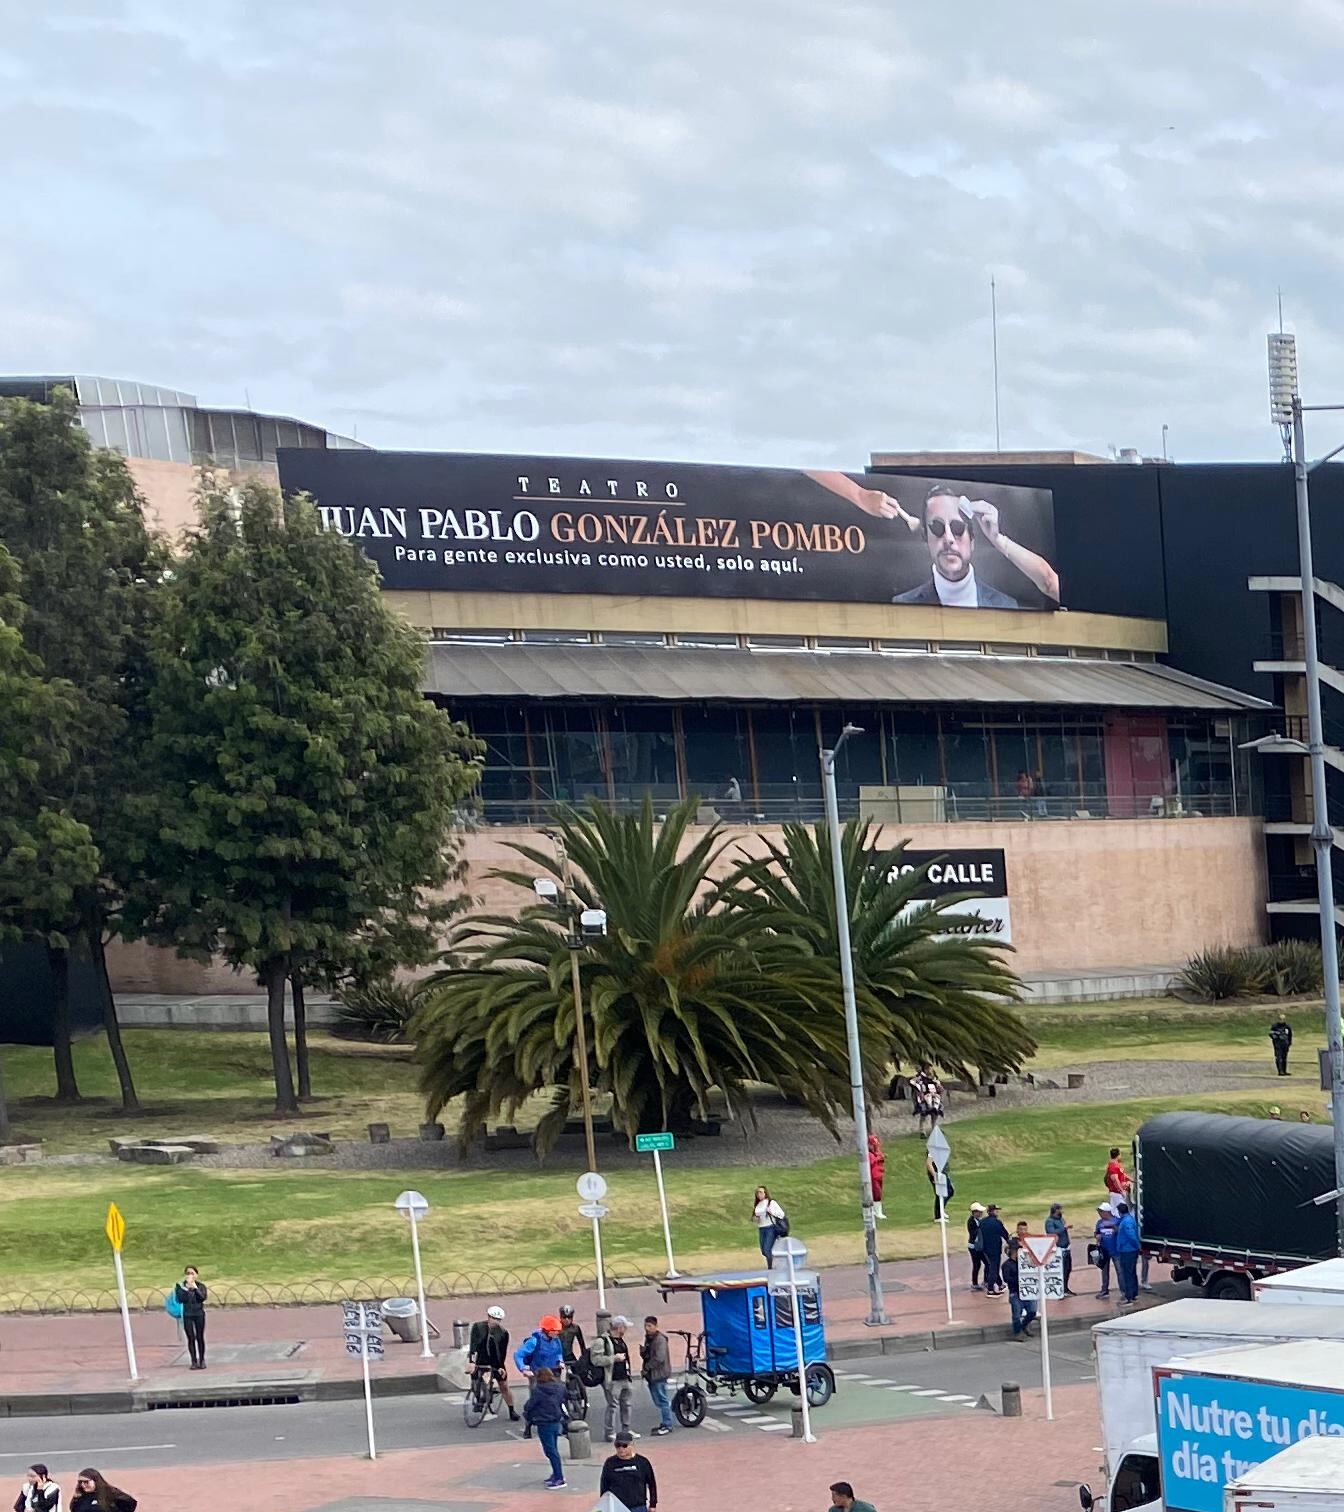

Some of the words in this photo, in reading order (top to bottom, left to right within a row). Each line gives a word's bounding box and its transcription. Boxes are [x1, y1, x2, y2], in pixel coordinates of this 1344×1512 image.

[517, 476, 679, 498] TEATRO
[418, 508, 540, 542] PABLO
[550, 509, 740, 548] GONZÁLEZ
[749, 520, 867, 554] POMBO
[395, 545, 437, 562] Para
[444, 548, 498, 565] gente
[505, 548, 592, 566] exclusiva
[598, 553, 649, 568] como
[655, 553, 712, 571] usted,
[717, 555, 754, 571] solo
[760, 556, 804, 575] aquí.
[927, 862, 995, 884] CALLE
[1167, 1390, 1253, 1440] Nutre
[1257, 1406, 1291, 1445] tu
[1172, 1440, 1219, 1483] día
